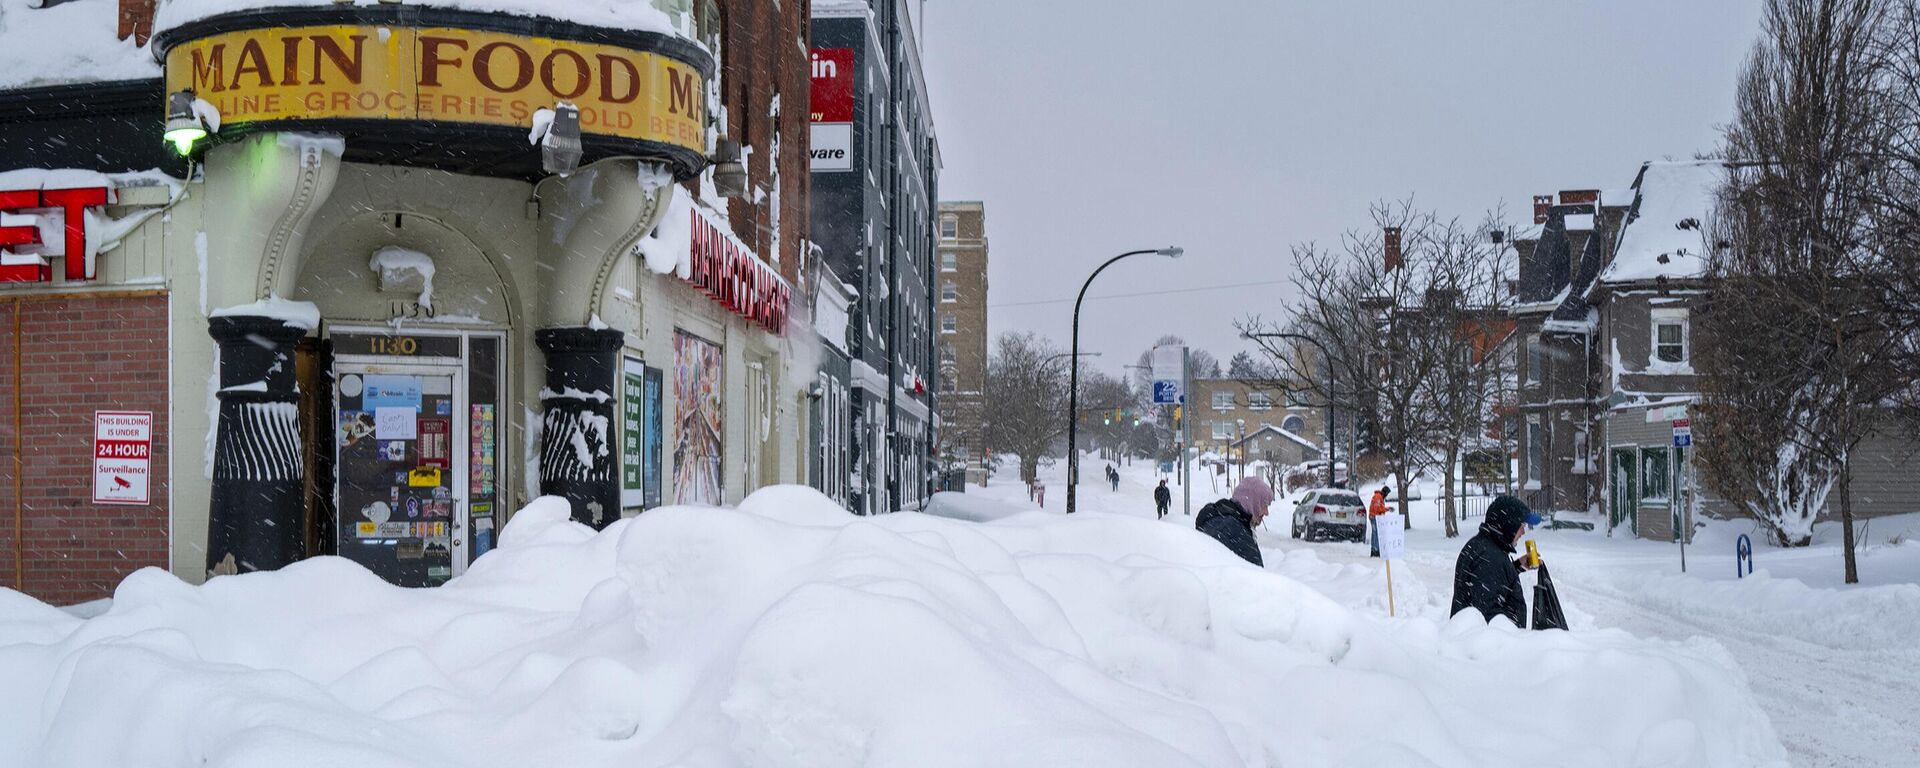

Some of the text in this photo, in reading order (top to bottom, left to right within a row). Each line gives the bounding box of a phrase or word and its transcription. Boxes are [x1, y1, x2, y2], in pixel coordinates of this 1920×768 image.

[190, 35, 368, 94] MAIN
[418, 36, 641, 104] FOOD
[220, 93, 280, 117] LINE
[304, 91, 529, 120] GROCERIES
[579, 106, 634, 130] OLD
[690, 207, 724, 299] MAIN
[725, 236, 756, 318] FOOD
[390, 301, 436, 319] 1130
[370, 336, 417, 355] 1130
[1162, 381, 1176, 391] 22
[99, 444, 147, 456] 24 HOUR
[98, 465, 146, 474] Surveillance
